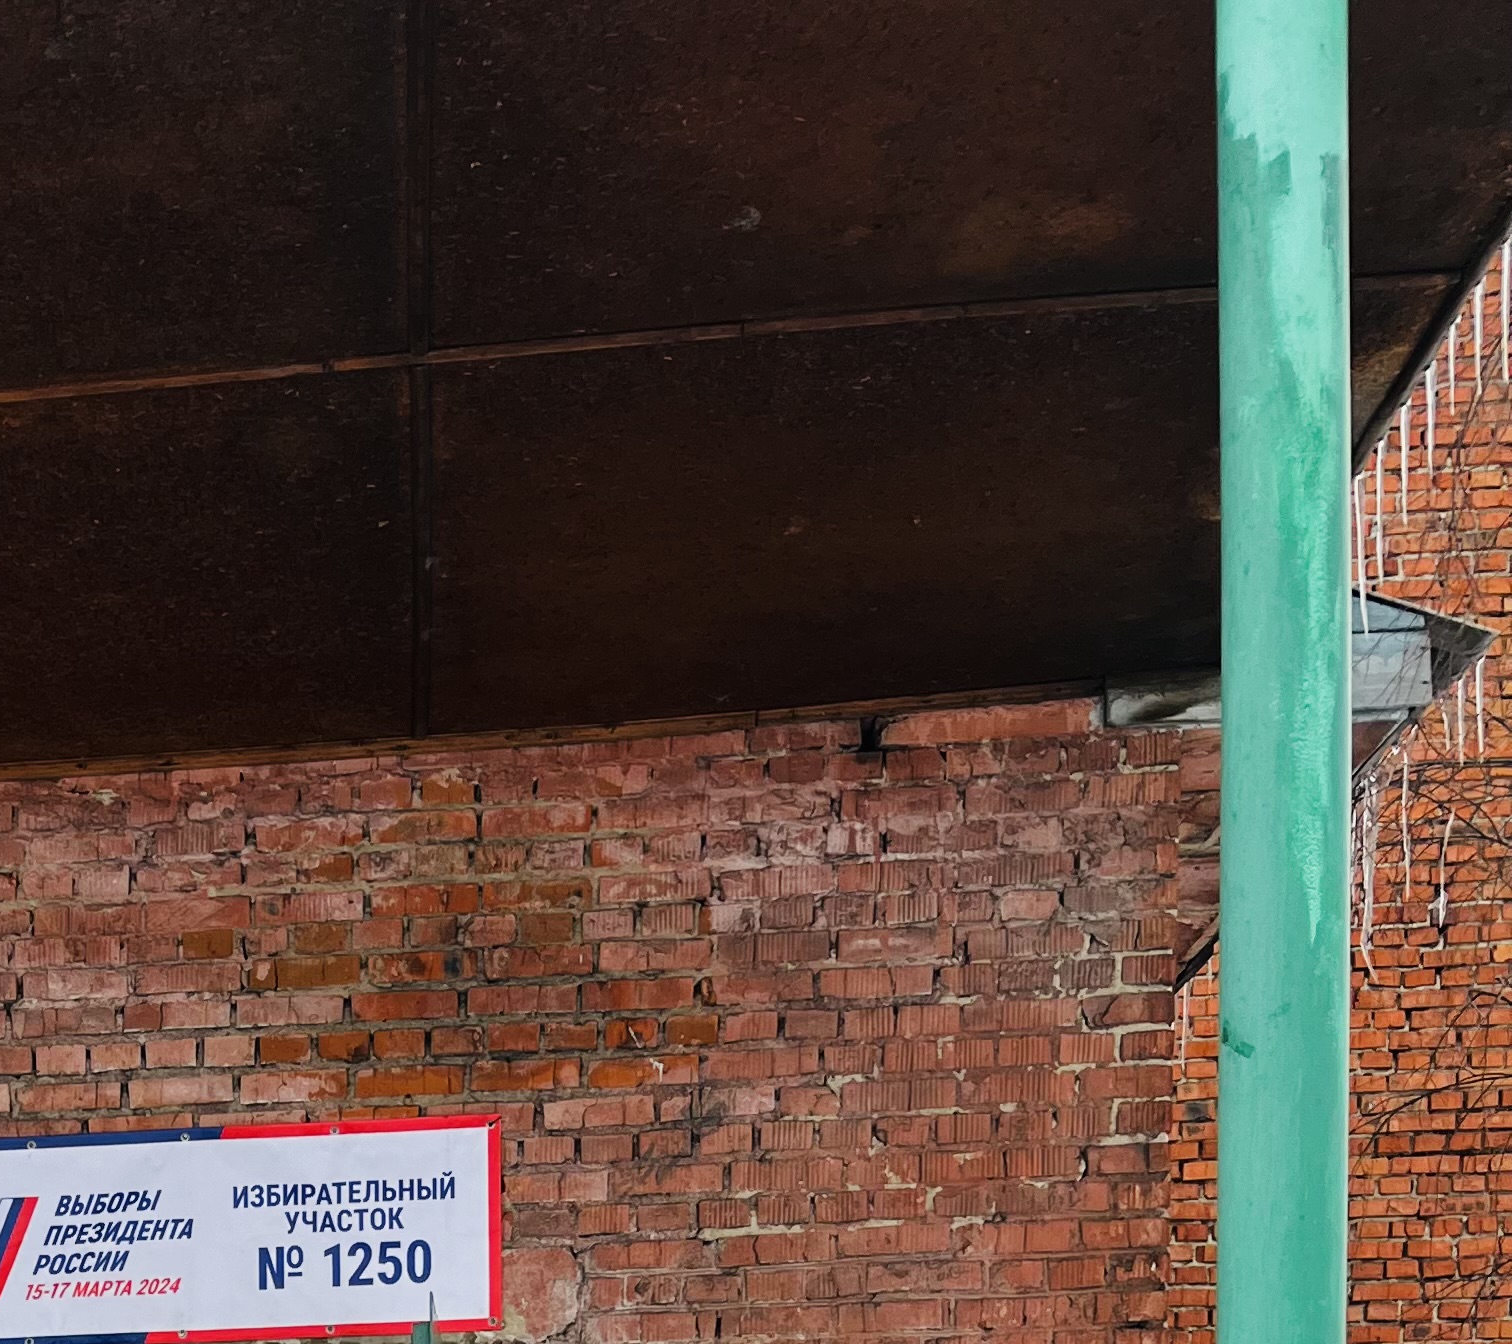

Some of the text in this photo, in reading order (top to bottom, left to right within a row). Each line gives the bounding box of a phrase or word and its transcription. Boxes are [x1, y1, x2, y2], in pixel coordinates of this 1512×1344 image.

[55, 1190, 162, 1216] ВЫБОРЫ
[233, 1171, 456, 1208] ИЗБИРАТЕЛЬНЫЙ
[44, 1219, 194, 1246] ПРЕЗИДЕНТА
[285, 1207, 404, 1234] УЧАСТОК
[33, 1250, 130, 1275] РОССИИ
[258, 1239, 432, 1290] № 1250
[25, 1277, 182, 1300] 15-17 МАРТА 2024
